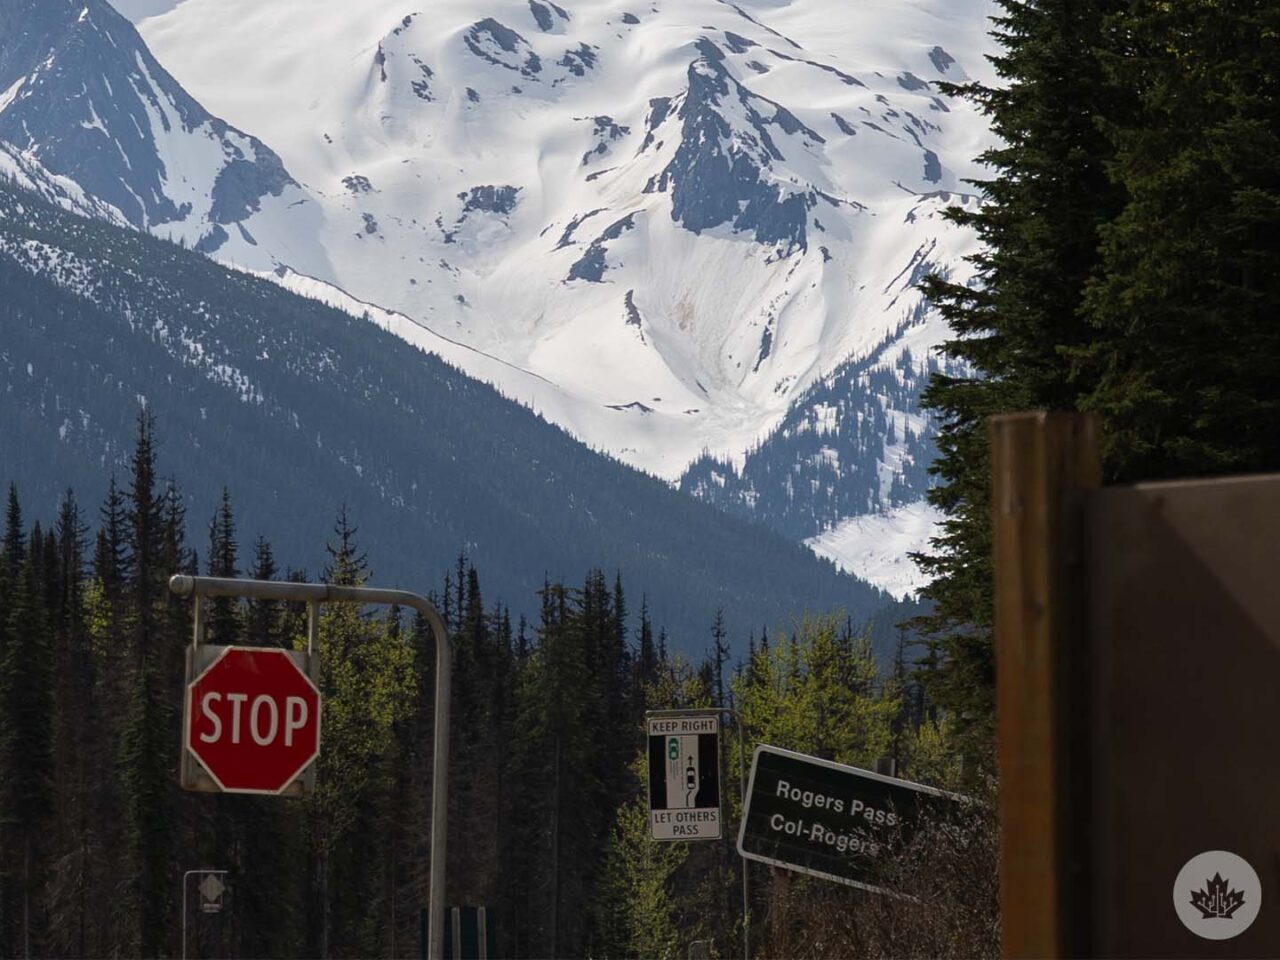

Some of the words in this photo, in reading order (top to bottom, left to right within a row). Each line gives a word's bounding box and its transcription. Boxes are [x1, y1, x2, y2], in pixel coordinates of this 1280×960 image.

[199, 691, 308, 747] STOP
[652, 722, 678, 732] KEEP
[681, 721, 714, 731] RIGHT
[776, 780, 845, 813] Rogers
[850, 799, 896, 826] Pass
[655, 813, 672, 824] LET
[676, 811, 716, 822] OTHERS
[672, 825, 700, 835] PASS
